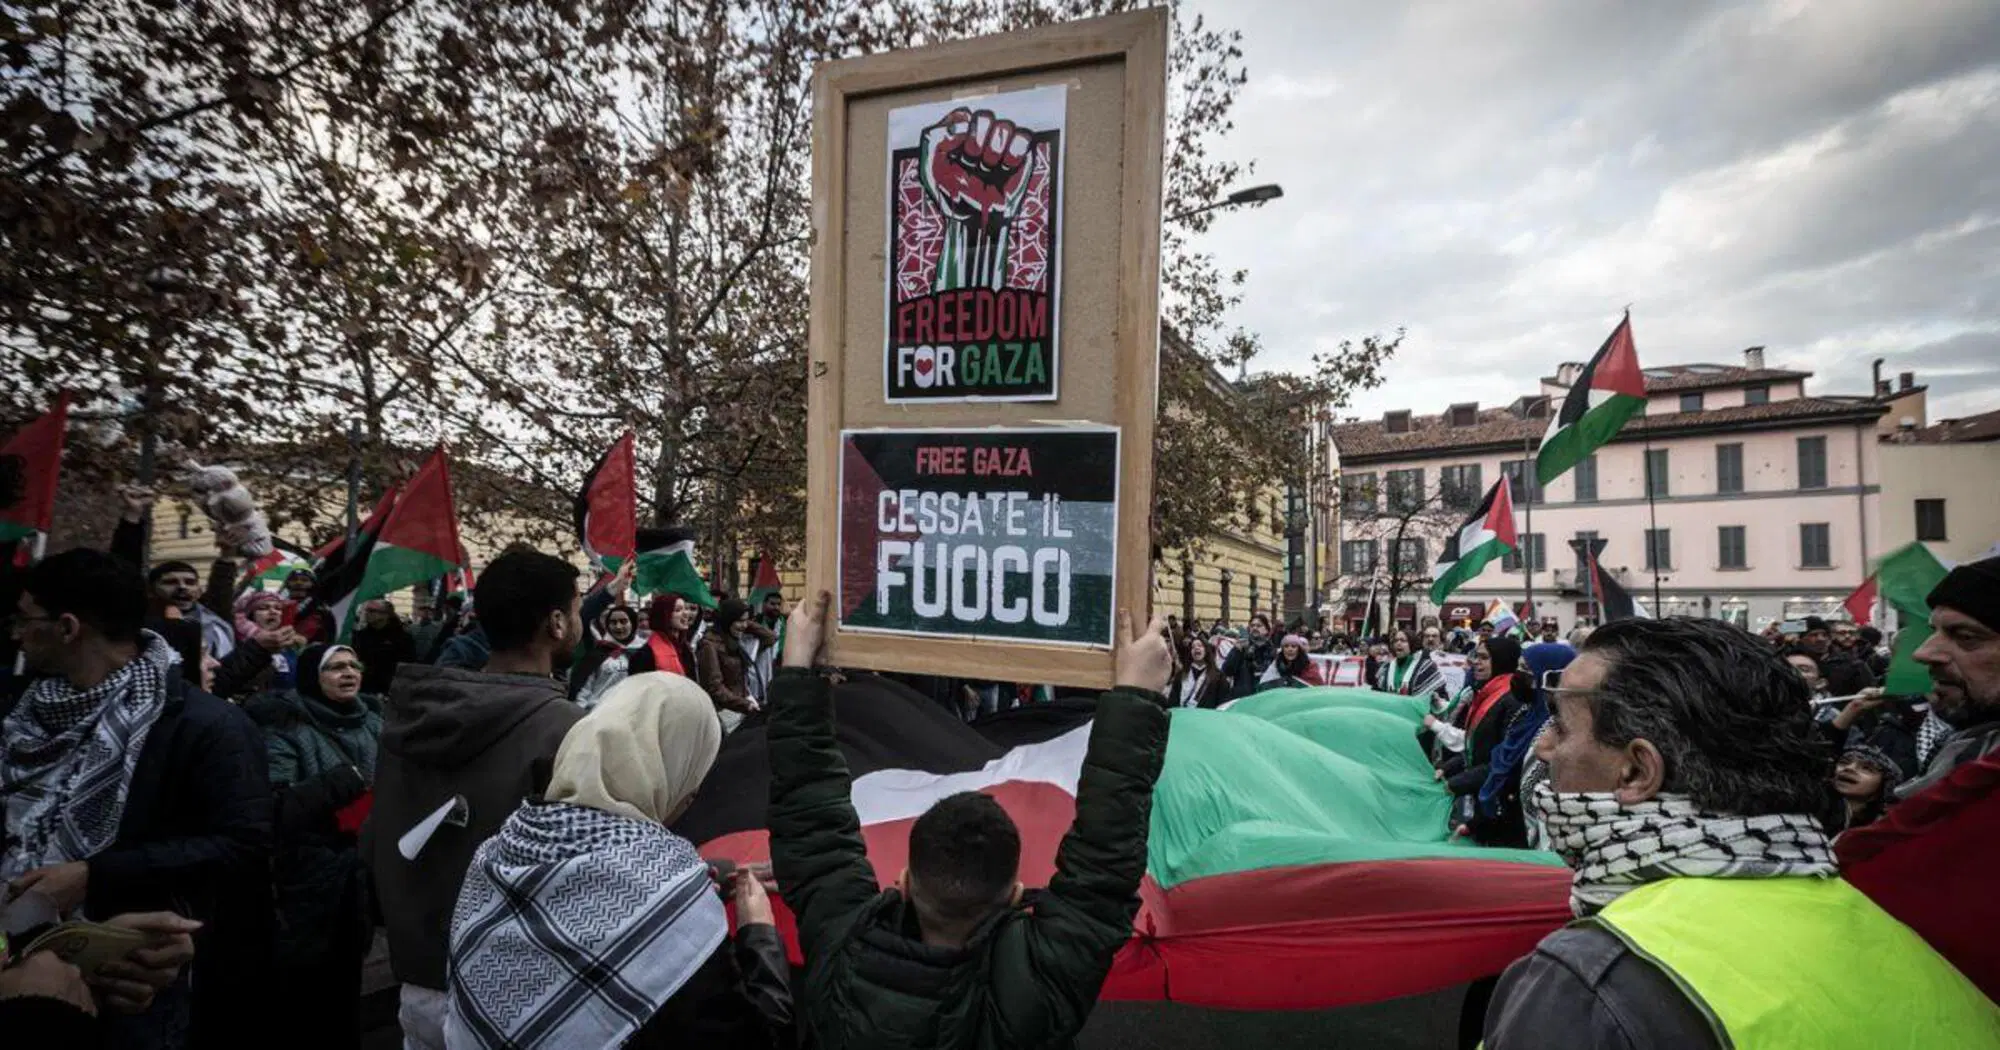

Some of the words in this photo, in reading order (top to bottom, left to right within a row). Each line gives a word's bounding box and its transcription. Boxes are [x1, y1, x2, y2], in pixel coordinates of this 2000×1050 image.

[897, 291, 1047, 343] FREEDOM
[897, 344, 956, 389] FOR
[960, 341, 1046, 386] GAZA
[915, 447, 967, 475] FREE
[972, 447, 1032, 477] GAZA
[877, 489, 1029, 537] CESSATE
[1042, 492, 1073, 538] IL
[876, 540, 1071, 627] FUOCO
